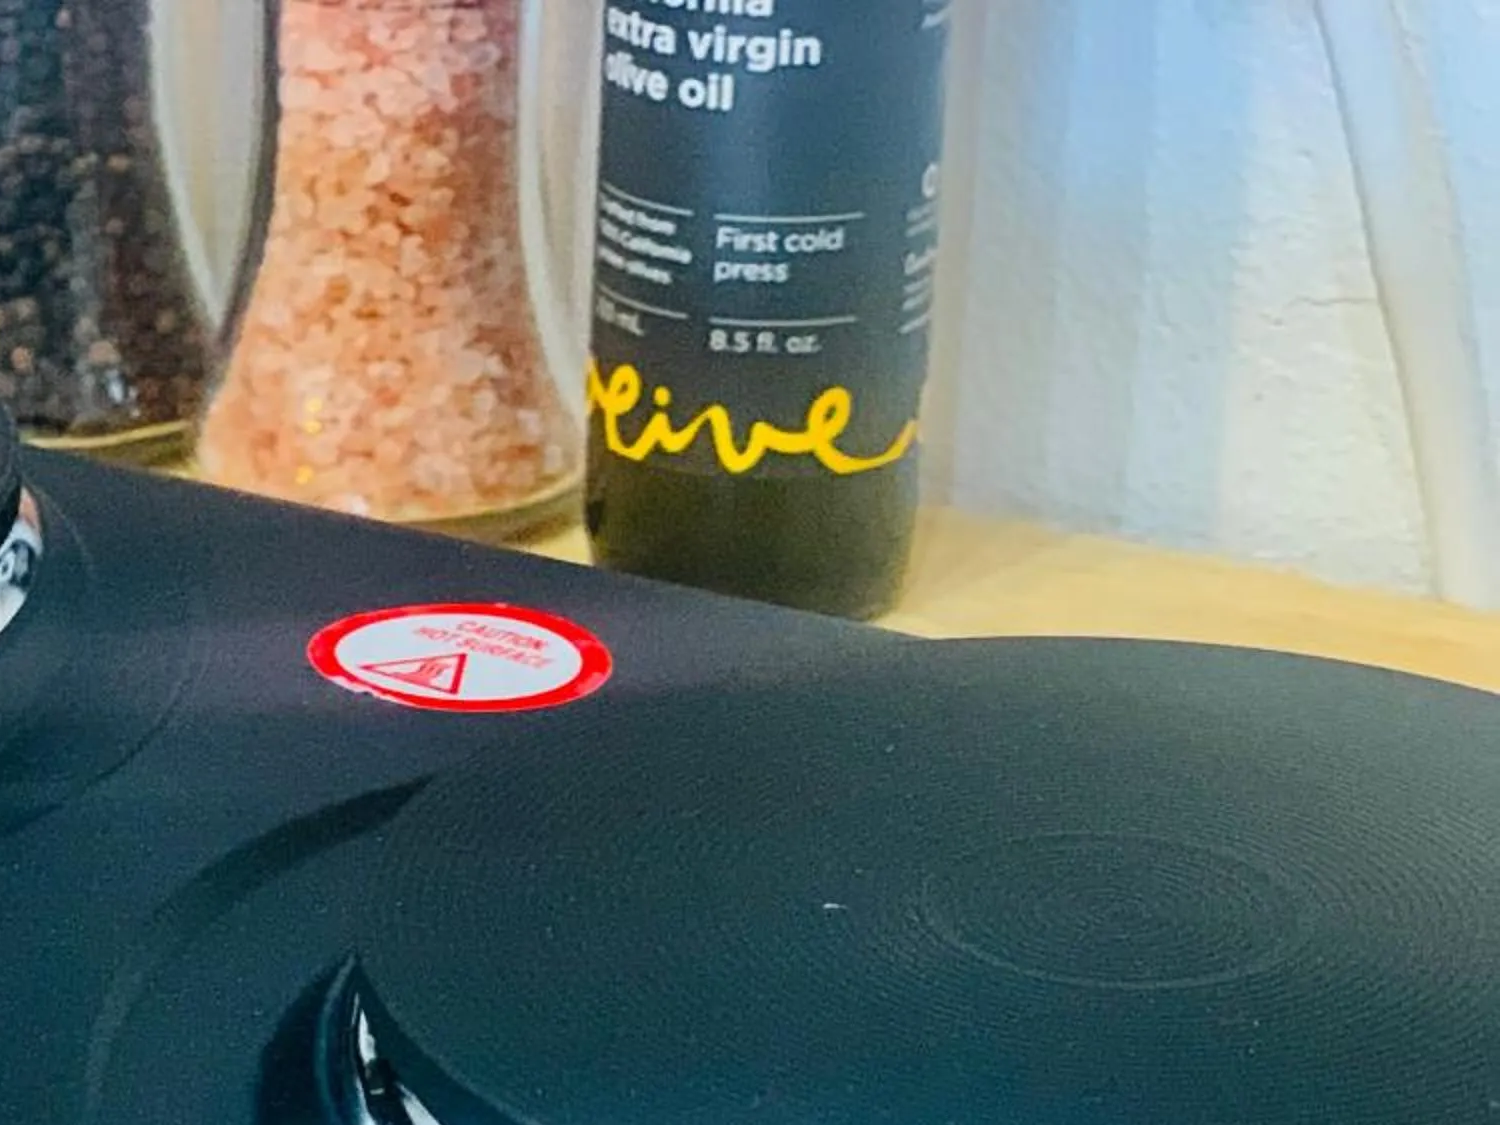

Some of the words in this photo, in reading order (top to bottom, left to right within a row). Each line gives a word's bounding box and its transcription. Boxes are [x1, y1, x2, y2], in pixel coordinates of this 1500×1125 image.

[688, 25, 821, 72] virgin
[678, 73, 734, 111] oil
[716, 226, 779, 253] First
[784, 226, 844, 253] cold
[713, 262, 789, 283] press
[709, 328, 750, 352] 8.5
[786, 334, 822, 353] oz.
